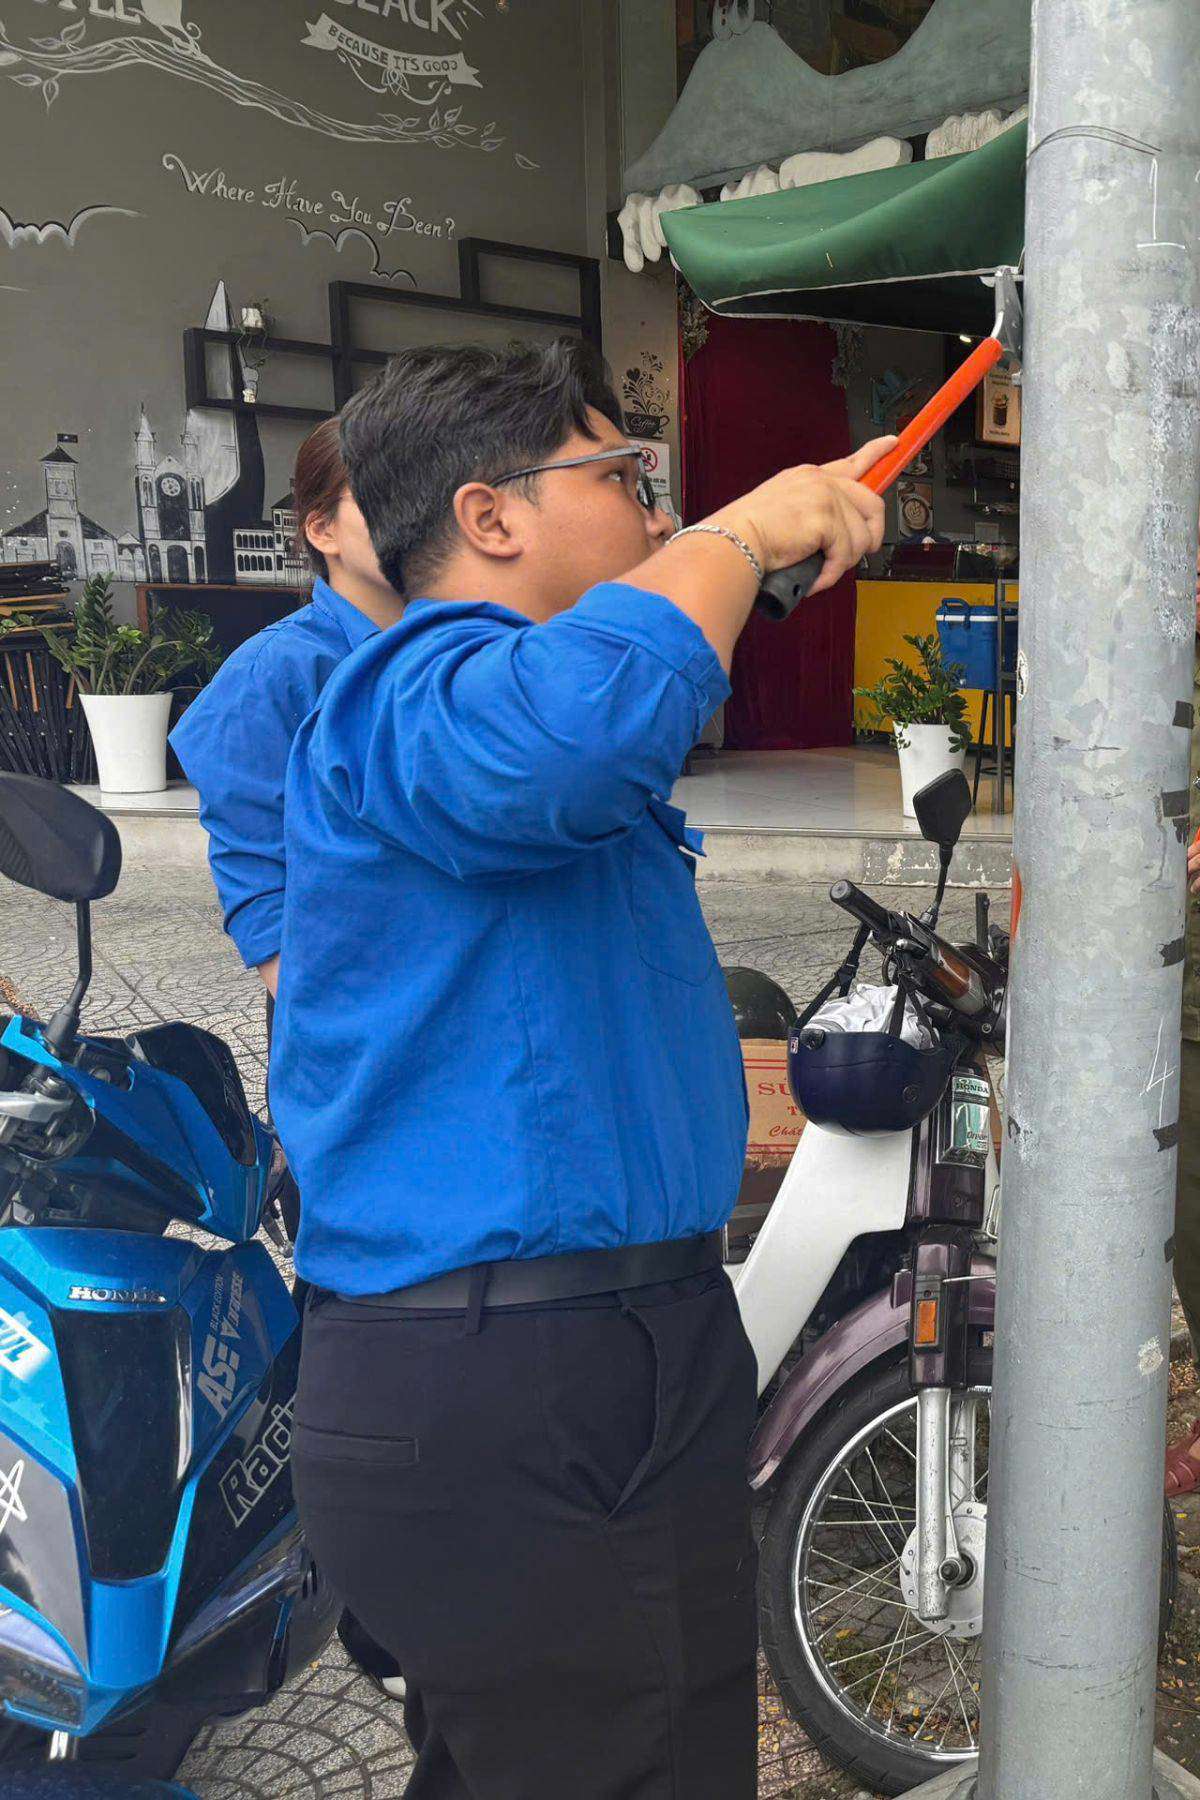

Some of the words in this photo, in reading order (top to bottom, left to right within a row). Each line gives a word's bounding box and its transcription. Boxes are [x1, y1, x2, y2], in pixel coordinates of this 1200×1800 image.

[328, 24, 390, 66] BECAUSE
[162, 153, 255, 203] Where
[262, 176, 324, 215] Have
[330, 190, 374, 225] You
[377, 197, 456, 240] Been?
[955, 1082, 990, 1095] HONDA
[68, 1285, 168, 1304] HONDA
